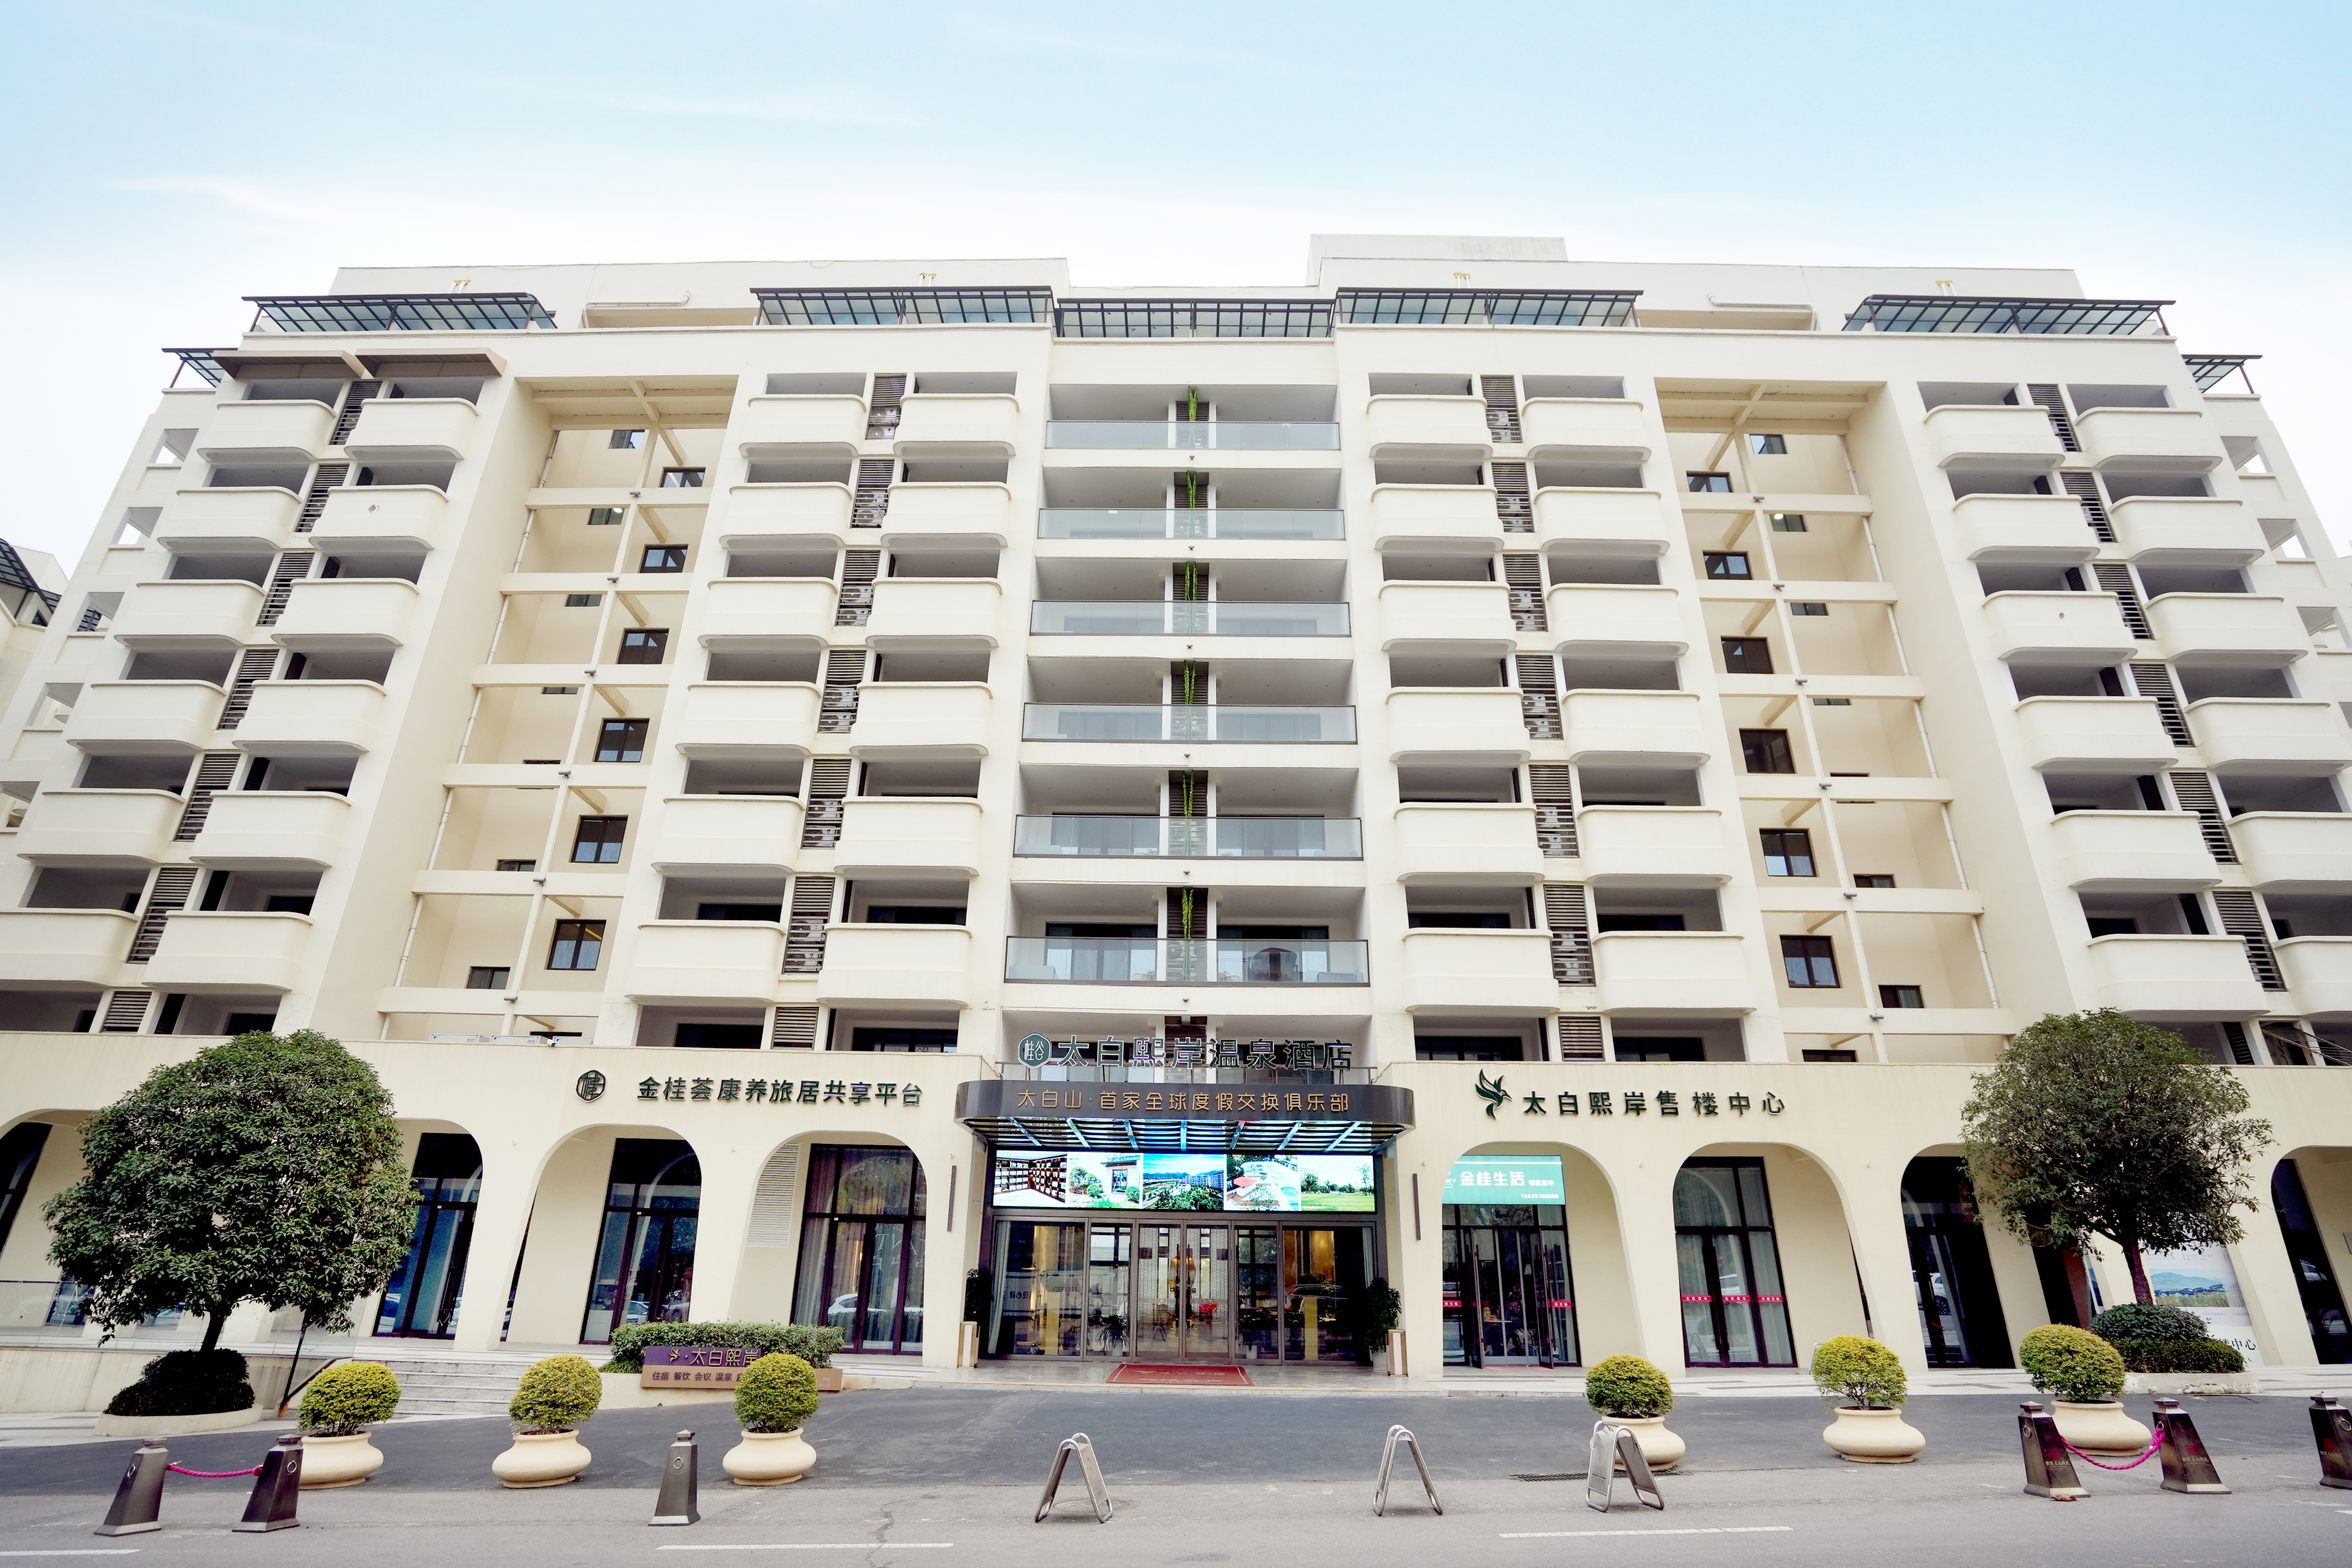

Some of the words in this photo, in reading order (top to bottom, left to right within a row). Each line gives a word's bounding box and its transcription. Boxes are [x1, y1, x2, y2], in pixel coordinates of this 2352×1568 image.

[1057, 1034, 1353, 1071] 太白熙岸温泉酒店
[637, 1077, 923, 1106] 金桂荟康养旅居共享平台
[1523, 1090, 1785, 1116] 太白熙岸售楼中心
[1460, 1171, 1525, 1186] 金桂生活
[689, 1348, 759, 1367] 太白熙岸
[652, 1371, 670, 1381] 住宿
[673, 1371, 691, 1381] 餐饮
[694, 1371, 712, 1381] 会议
[715, 1372, 732, 1381] 温泉
